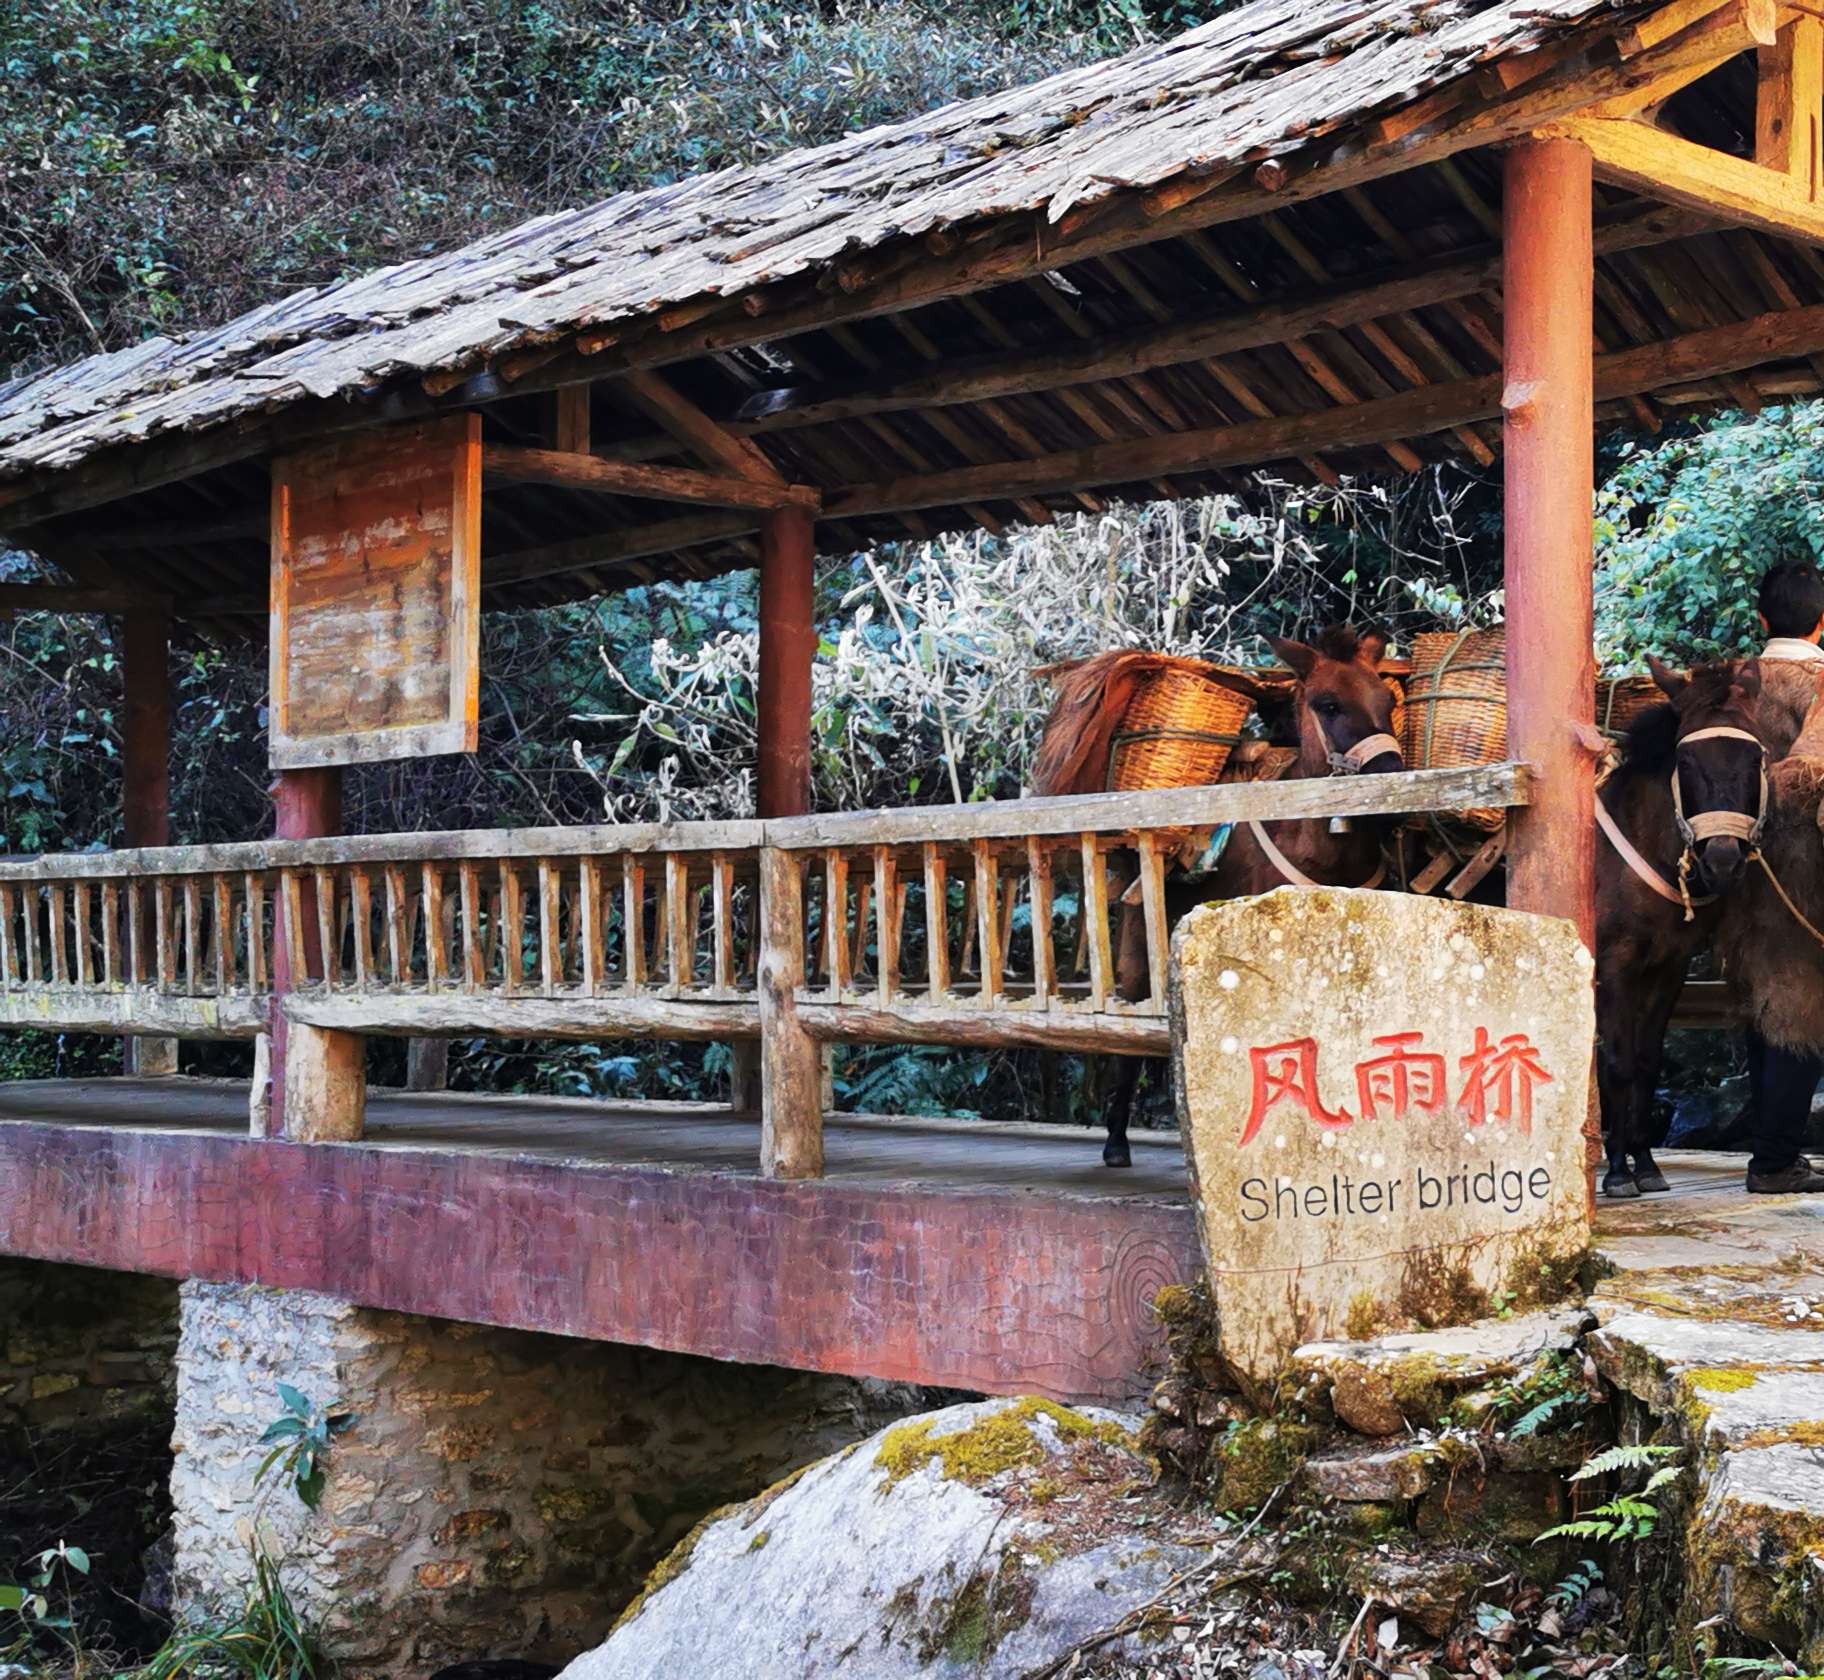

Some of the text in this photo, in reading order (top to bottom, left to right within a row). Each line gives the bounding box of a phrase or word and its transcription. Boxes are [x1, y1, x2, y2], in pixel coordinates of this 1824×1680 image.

[1238, 1026, 1553, 1148] 风雨桥
[1240, 1161, 1552, 1222] Shelter bridge
